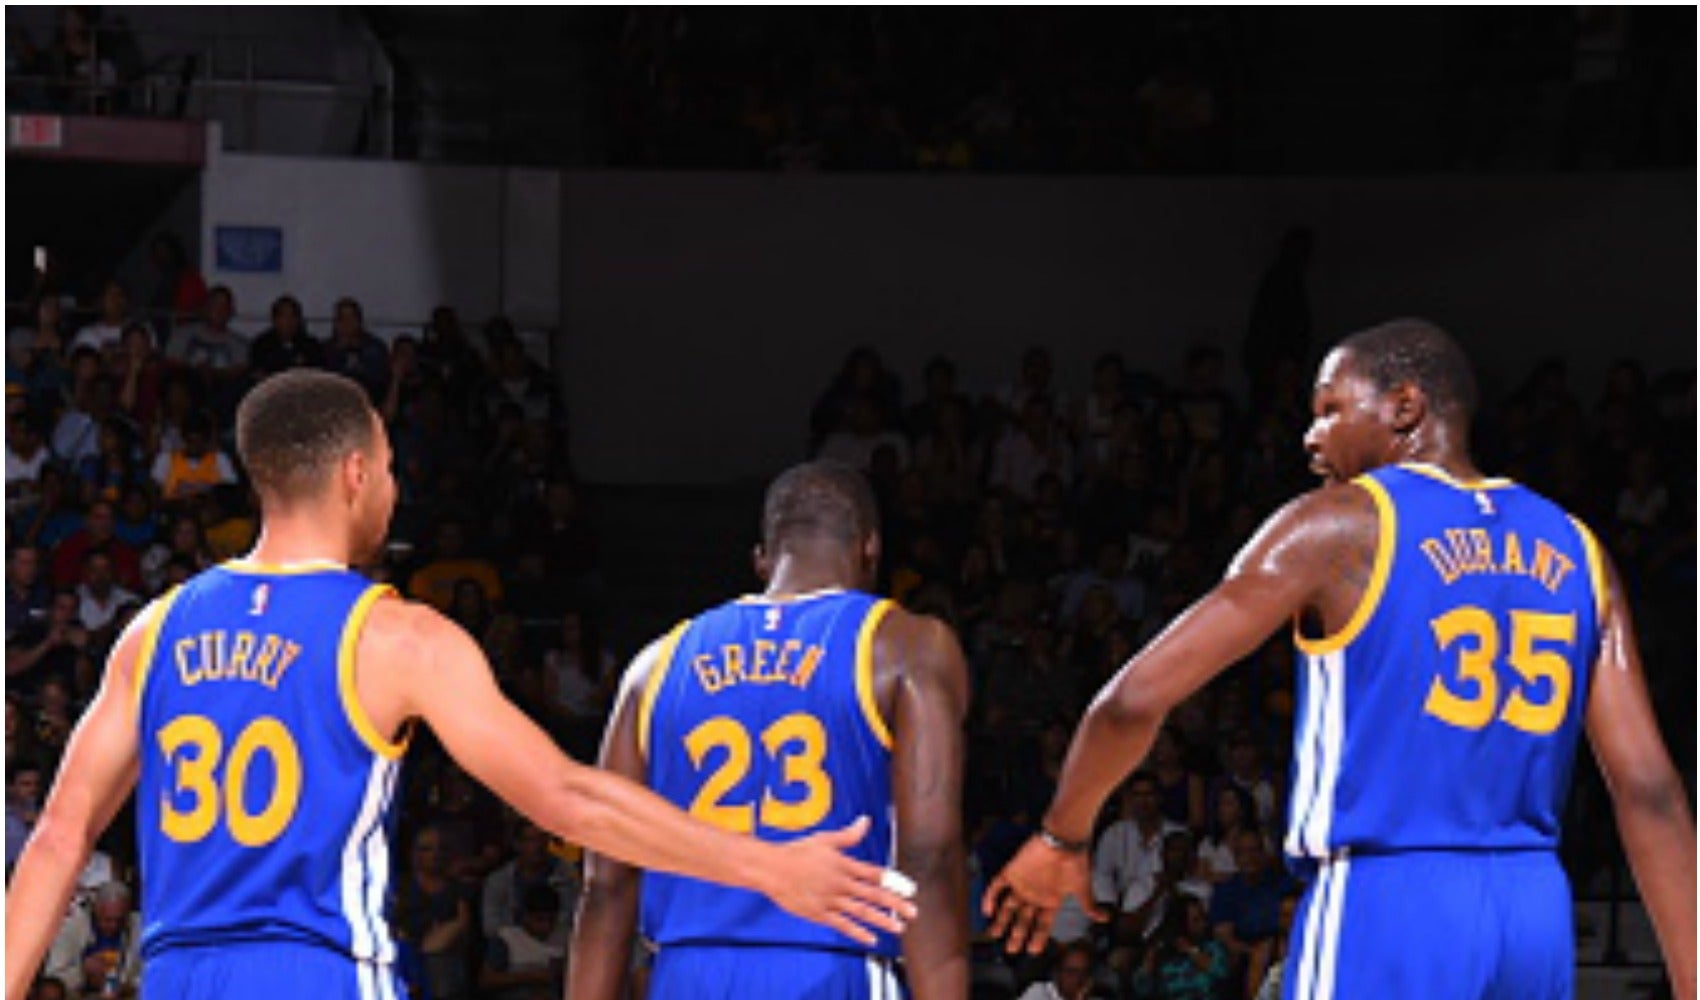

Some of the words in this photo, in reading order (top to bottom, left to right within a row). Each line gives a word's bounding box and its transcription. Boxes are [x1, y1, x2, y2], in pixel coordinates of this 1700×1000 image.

[1419, 528, 1576, 594] DURANT
[174, 630, 302, 690] CURRY
[691, 638, 826, 694] GREEN
[1424, 605, 1577, 735] 35
[155, 714, 303, 848] 30
[683, 712, 833, 834] 23
